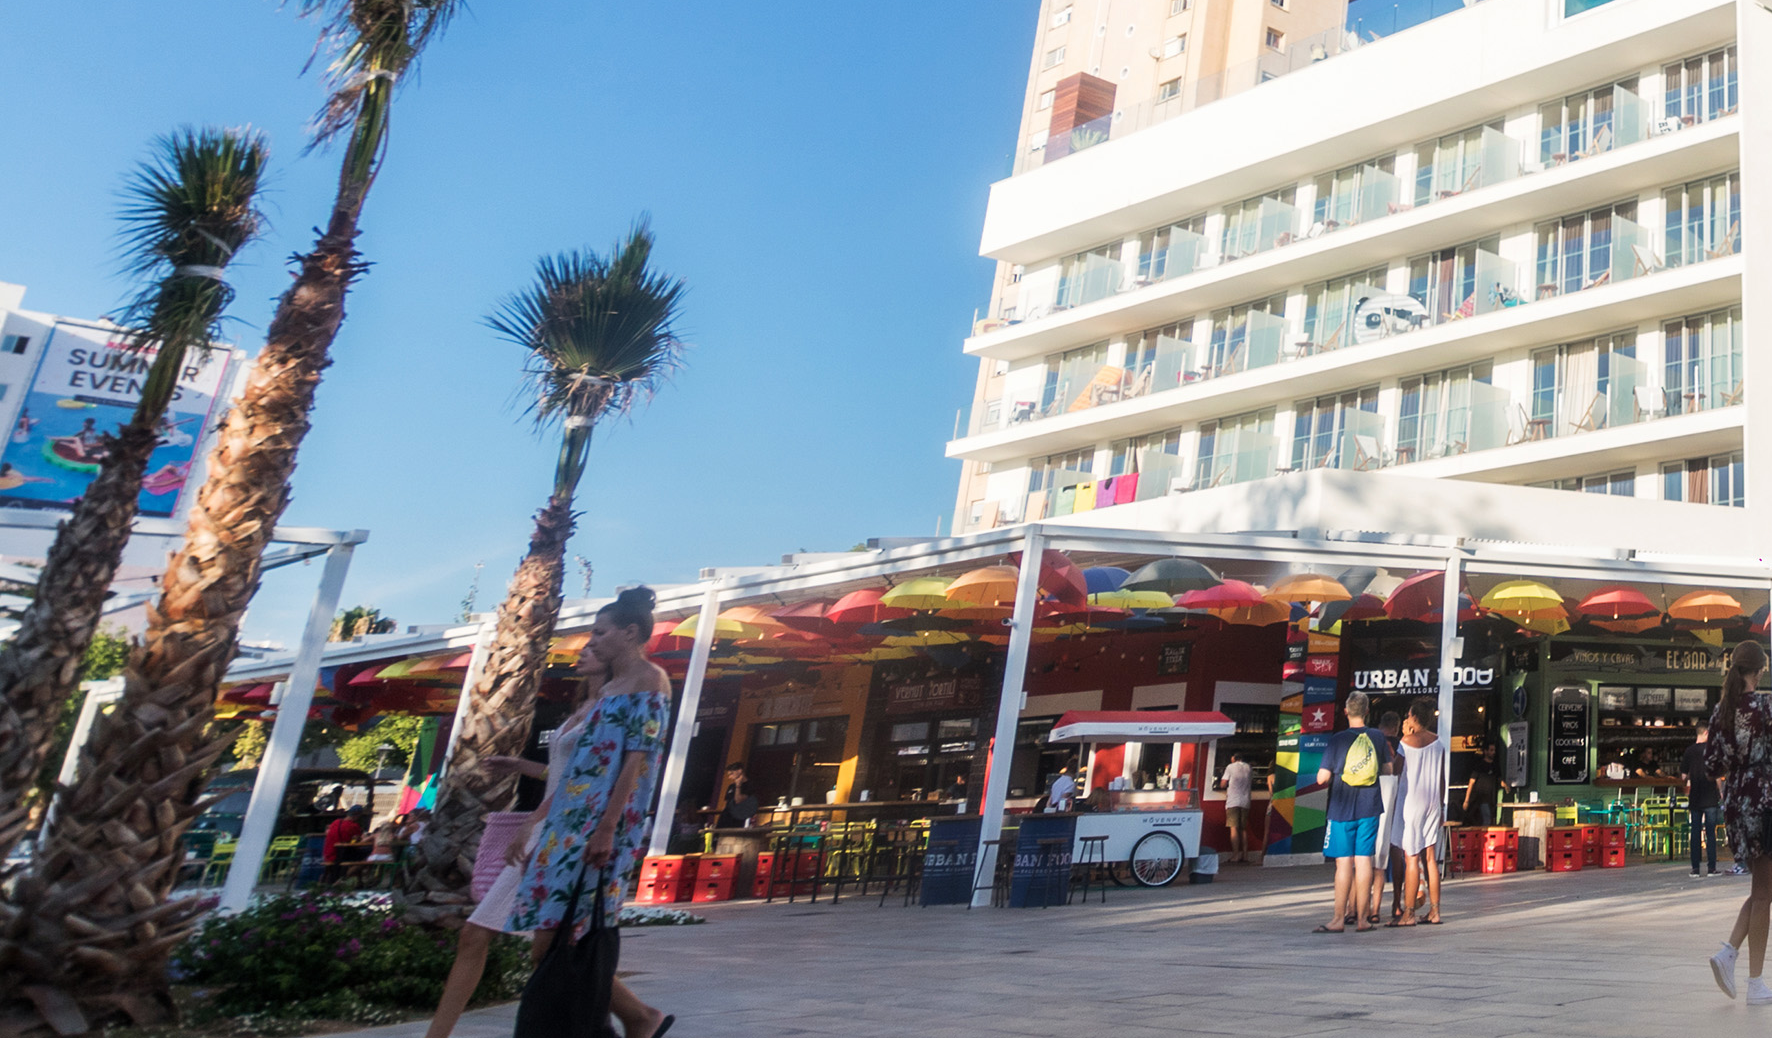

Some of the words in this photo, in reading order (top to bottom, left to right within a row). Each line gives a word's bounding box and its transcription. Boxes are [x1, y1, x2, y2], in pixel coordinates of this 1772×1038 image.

[67, 348, 200, 384] SUMR
[68, 370, 185, 402] EVENS
[1574, 651, 1599, 663] VINOS
[1602, 652, 1608, 664] Y
[1610, 653, 1635, 664] CAVAS
[1666, 650, 1680, 669] EL
[1683, 651, 1707, 670] BAR
[1354, 668, 1430, 690] URBAN
[1400, 686, 1439, 695] MALLORC
[1142, 816, 1192, 824] MÖVENPICK
